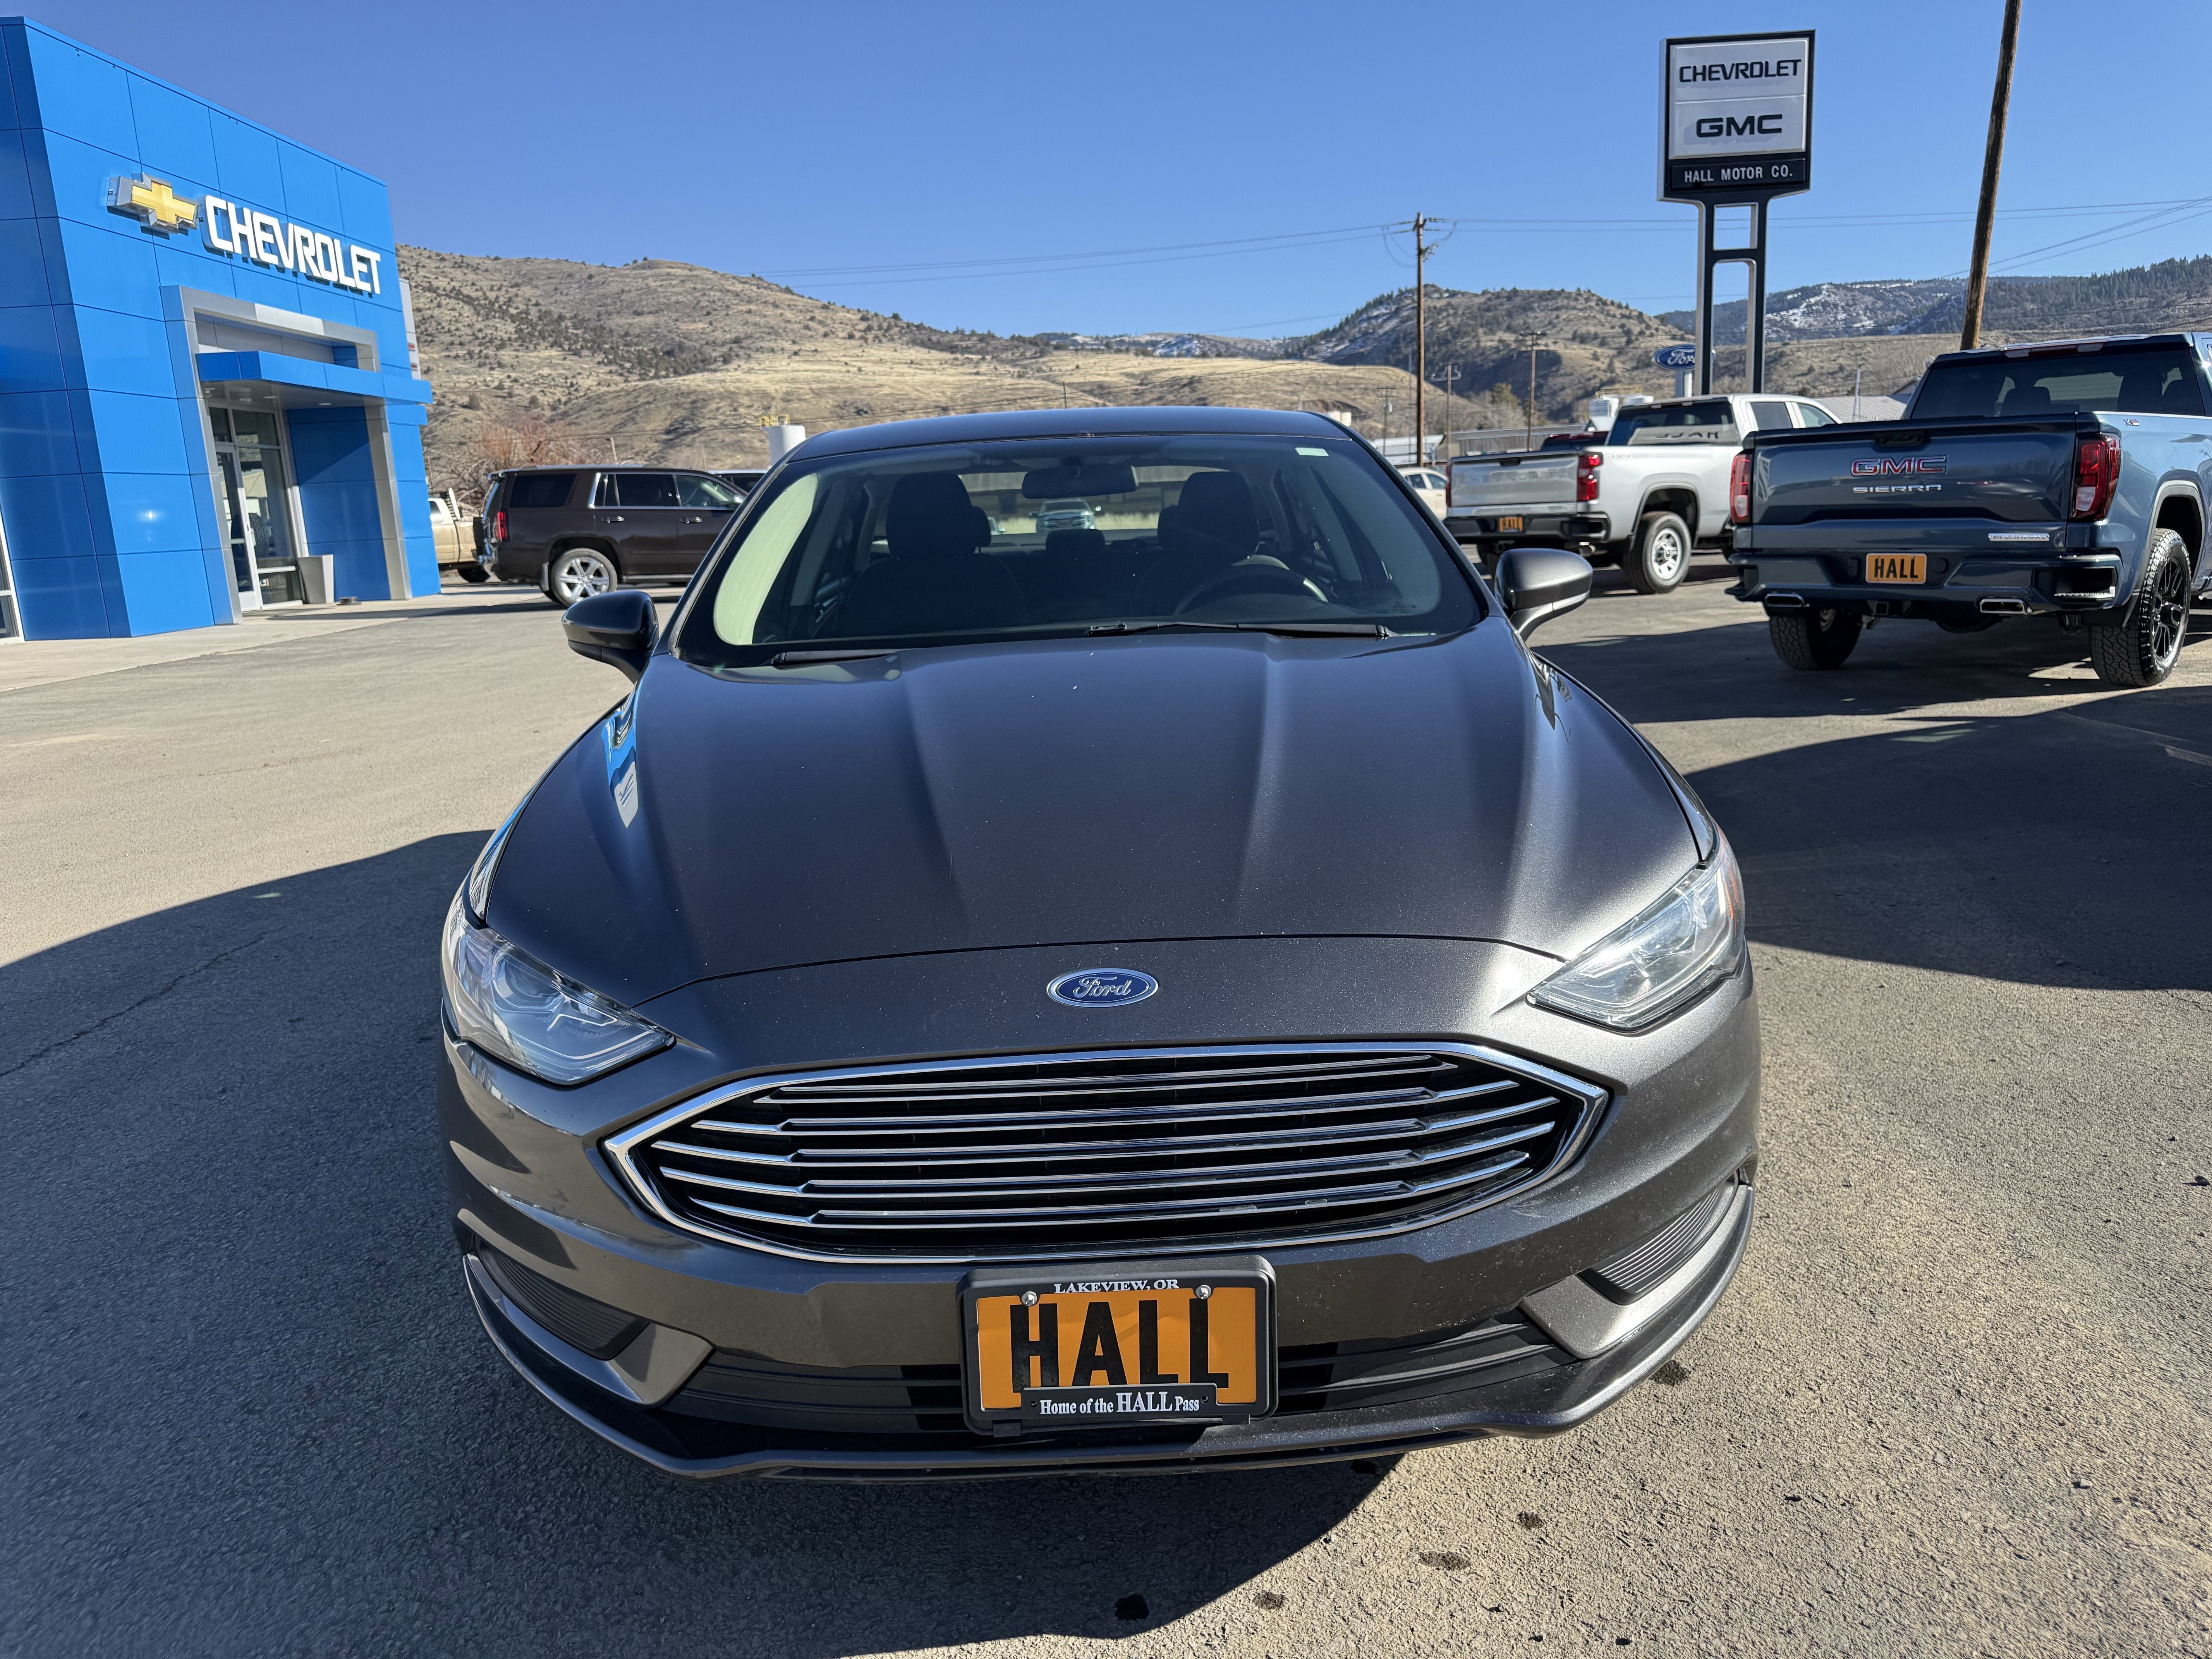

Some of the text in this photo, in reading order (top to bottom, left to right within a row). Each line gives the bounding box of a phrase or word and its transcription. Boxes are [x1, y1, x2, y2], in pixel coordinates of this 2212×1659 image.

[1680, 59, 1802, 82] CHEVROLET
[1696, 114, 1783, 138] GMC
[1685, 165, 1793, 183] HALL MOTOR CO.
[206, 195, 381, 295] CHEVROLET
[1667, 349, 1695, 365] For
[1851, 455, 1947, 476] GMC
[1853, 484, 1942, 493] SIERRA
[1874, 559, 1918, 578] HALL
[1073, 976, 1132, 998] Ford
[1054, 1279, 1180, 1293] LAKEVIEW, OR
[1010, 1298, 1229, 1393] HALL
[1040, 1392, 1200, 1415] Home of the HALL Pass
